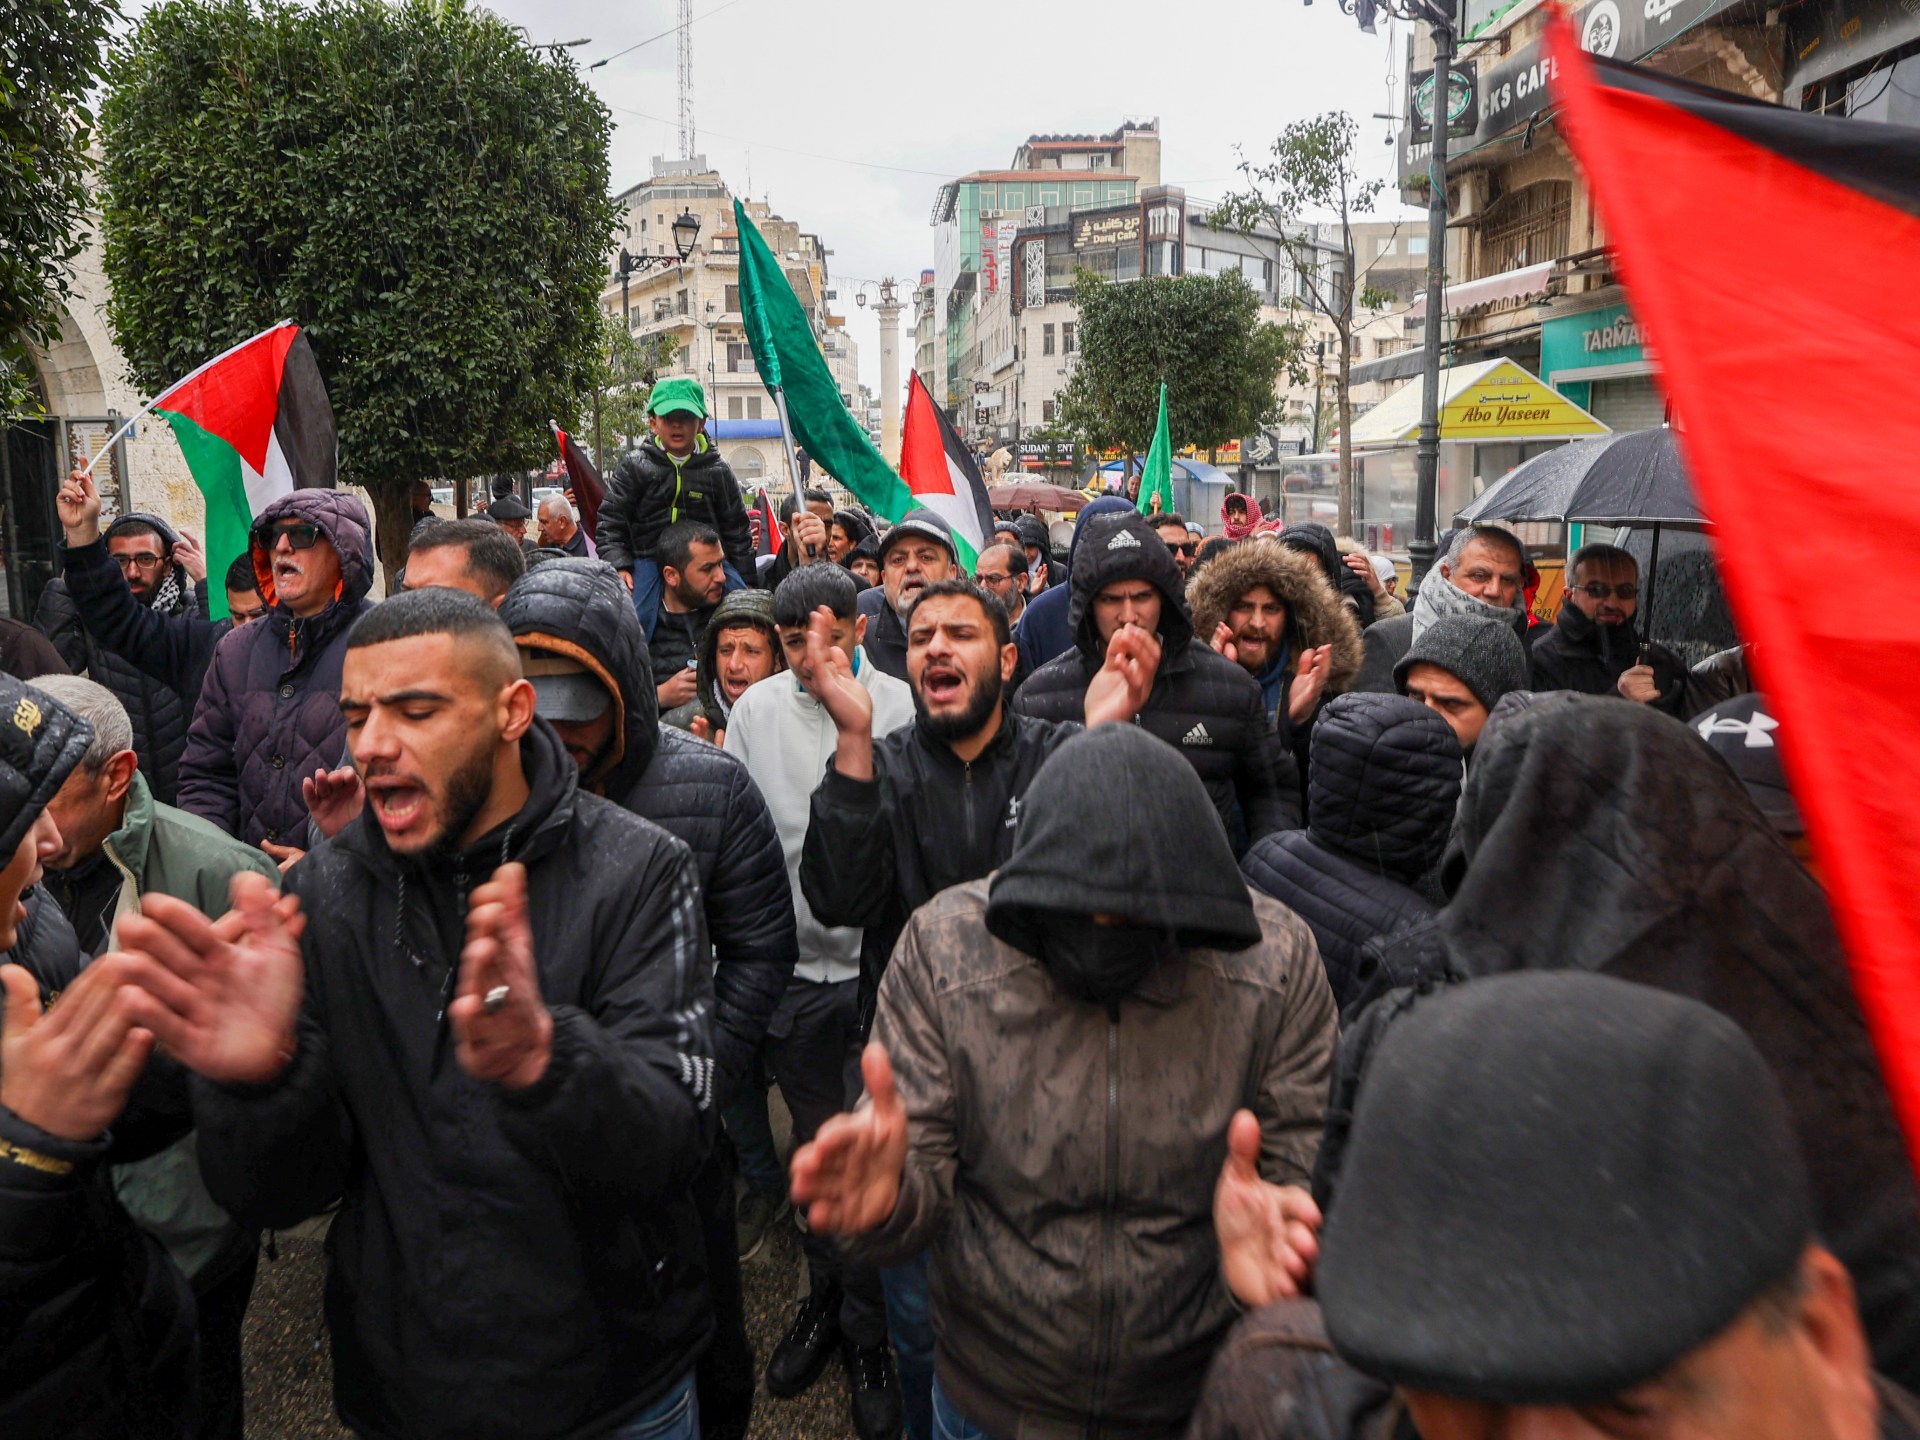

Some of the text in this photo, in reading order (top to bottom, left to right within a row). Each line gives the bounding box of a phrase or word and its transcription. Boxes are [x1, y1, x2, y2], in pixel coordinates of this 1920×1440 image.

[1479, 82, 1511, 121] CKS
[1093, 232, 1116, 244] Daraj
[1460, 405, 1551, 425] Abo Yaseen
[1107, 539, 1142, 550] adidas
[1182, 735, 1213, 746] adidas
